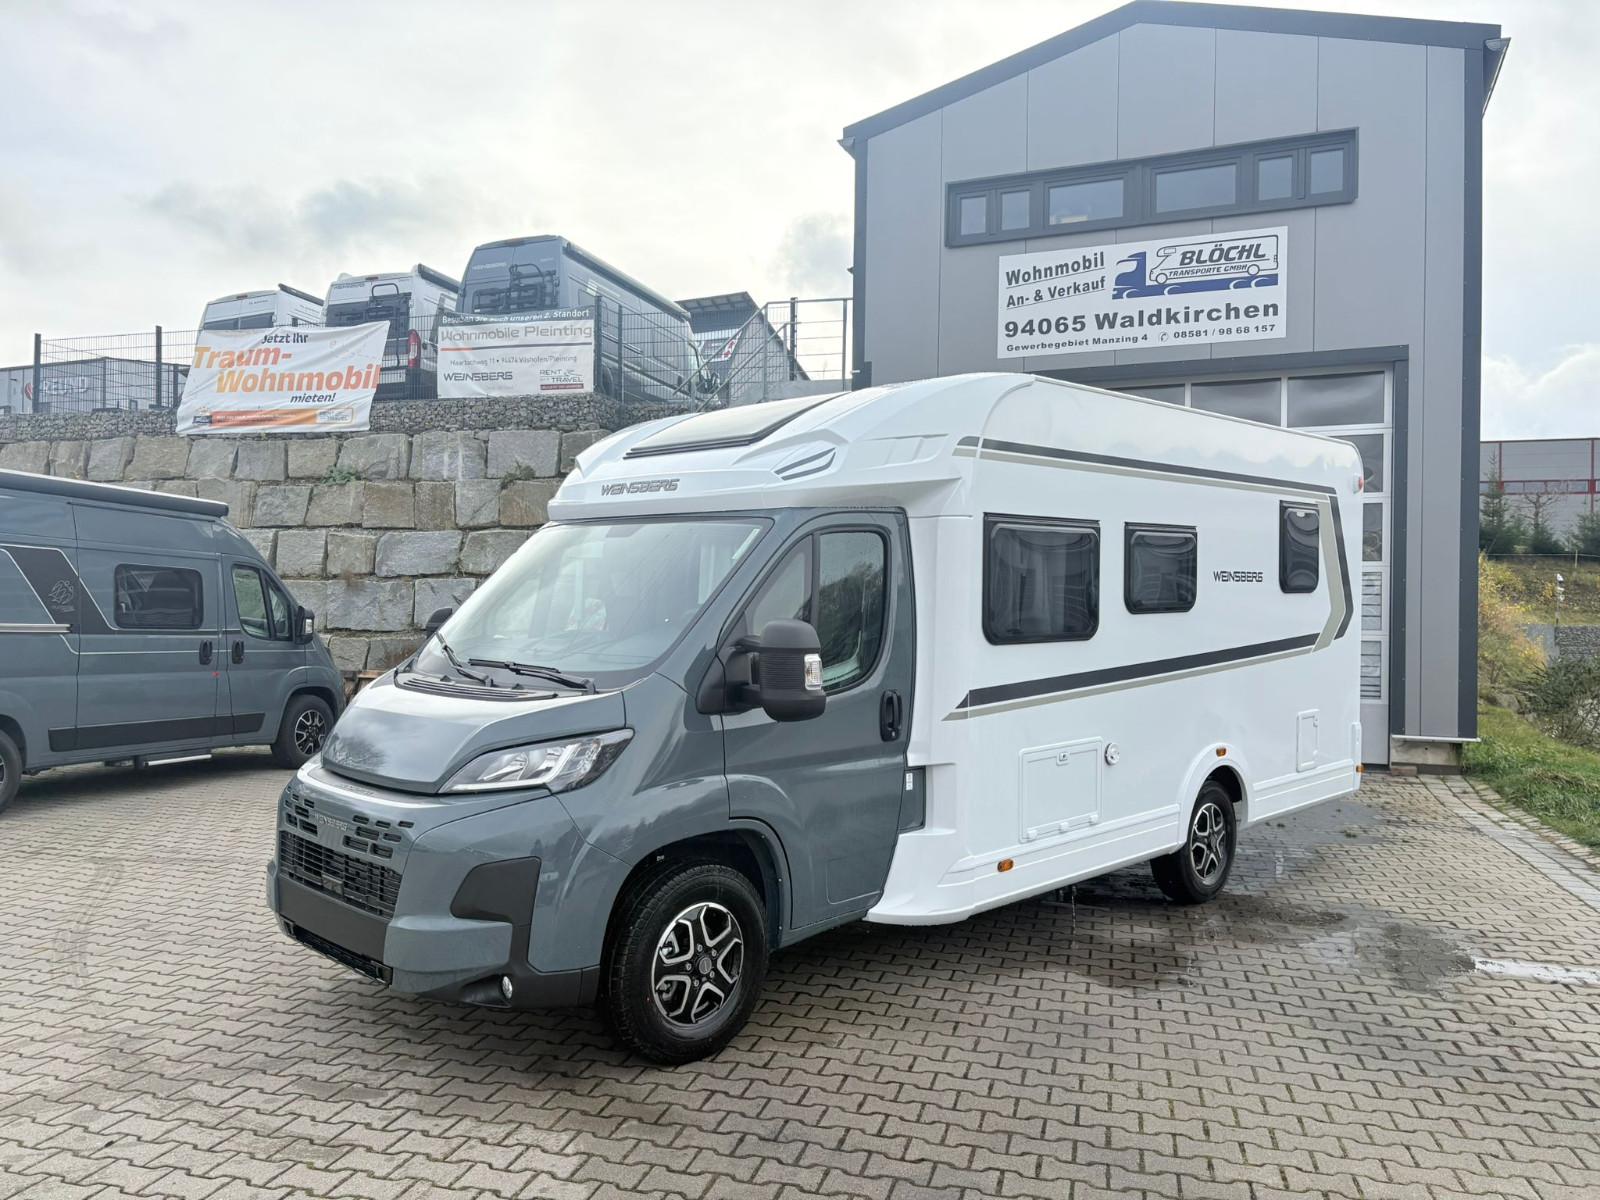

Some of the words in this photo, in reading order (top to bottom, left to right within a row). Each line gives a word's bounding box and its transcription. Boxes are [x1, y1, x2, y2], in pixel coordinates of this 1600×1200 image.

[1180, 243, 1266, 266] BLÖCHL
[1005, 251, 1105, 286] Wohnmobil
[1169, 266, 1222, 277] TRANSPORTE
[1223, 264, 1248, 272] GMBH
[1006, 294, 1030, 308] An-
[1033, 289, 1044, 302] &
[1048, 276, 1106, 299] Verkauf
[553, 309, 590, 319] Standort
[1004, 315, 1087, 338] 94065
[1094, 302, 1280, 330] Waldkirchen
[262, 334, 291, 344] Jetzt
[292, 332, 309, 344] Ihr
[440, 326, 520, 342] Wohnmobile
[524, 325, 593, 339] Pleinting
[1173, 329, 1209, 339] 08581
[1218, 328, 1232, 336] 98
[1235, 326, 1250, 334] 68
[1254, 324, 1276, 333] 157
[1006, 339, 1089, 352] Gewerbegebiet
[1092, 335, 1139, 345] Manzing
[193, 345, 293, 370] Traum-
[216, 364, 382, 393] Wohnmobil
[443, 371, 513, 382] WEINSBERG
[290, 392, 336, 404] mieten!
[601, 478, 680, 496] WEINSBERG
[1213, 571, 1264, 583] WEINSBERG
